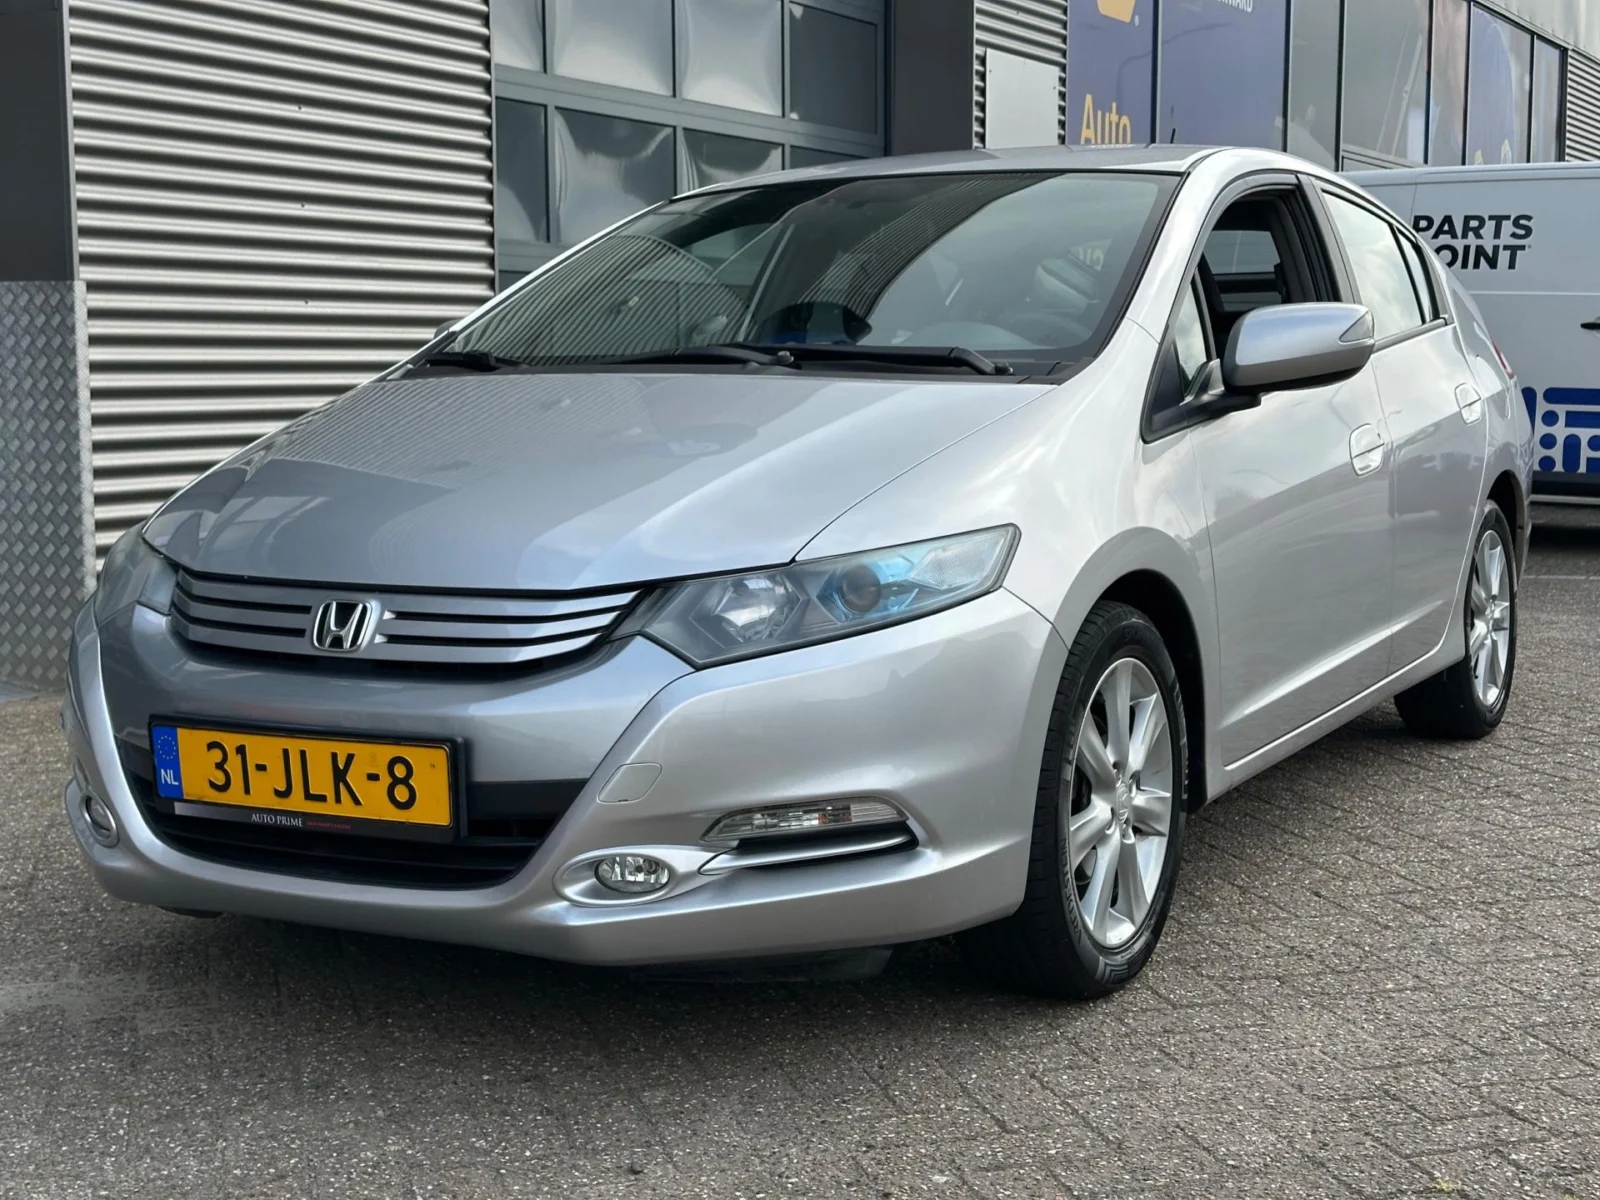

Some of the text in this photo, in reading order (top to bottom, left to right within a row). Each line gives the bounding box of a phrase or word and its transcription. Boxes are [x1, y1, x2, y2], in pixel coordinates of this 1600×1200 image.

[1080, 94, 1131, 144] Auto
[1412, 214, 1534, 240] PARTS
[1434, 244, 1526, 270] OINT
[160, 769, 179, 786] NL
[206, 740, 417, 811] 31-JLK-8
[251, 813, 275, 824] AUTO
[277, 815, 304, 827] PRIME
